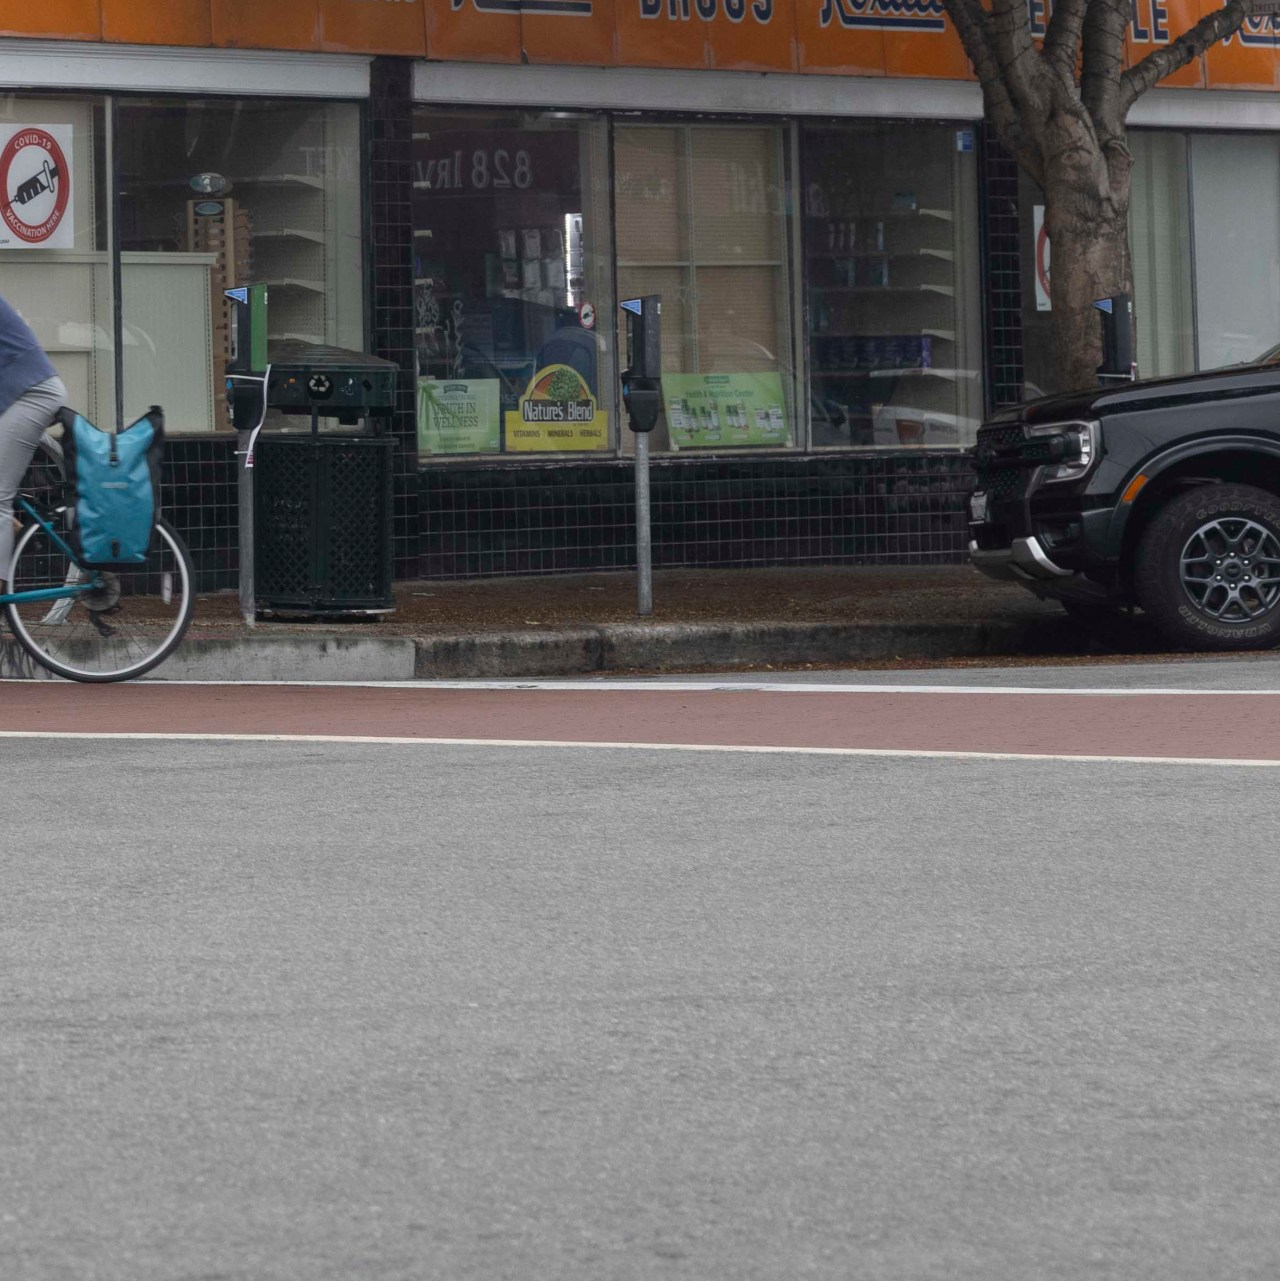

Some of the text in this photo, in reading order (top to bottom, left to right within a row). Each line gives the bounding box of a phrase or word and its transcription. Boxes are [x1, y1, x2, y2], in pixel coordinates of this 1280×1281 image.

[14, 134, 52, 150] COVID-19
[6, 209, 59, 238] VACCINATION HERE
[466, 402, 476, 414] IN
[524, 400, 593, 421] Nature's Blend
[433, 416, 479, 429] WELLNESS
[513, 429, 602, 438] VITAMINS MINERALS HERBALS
